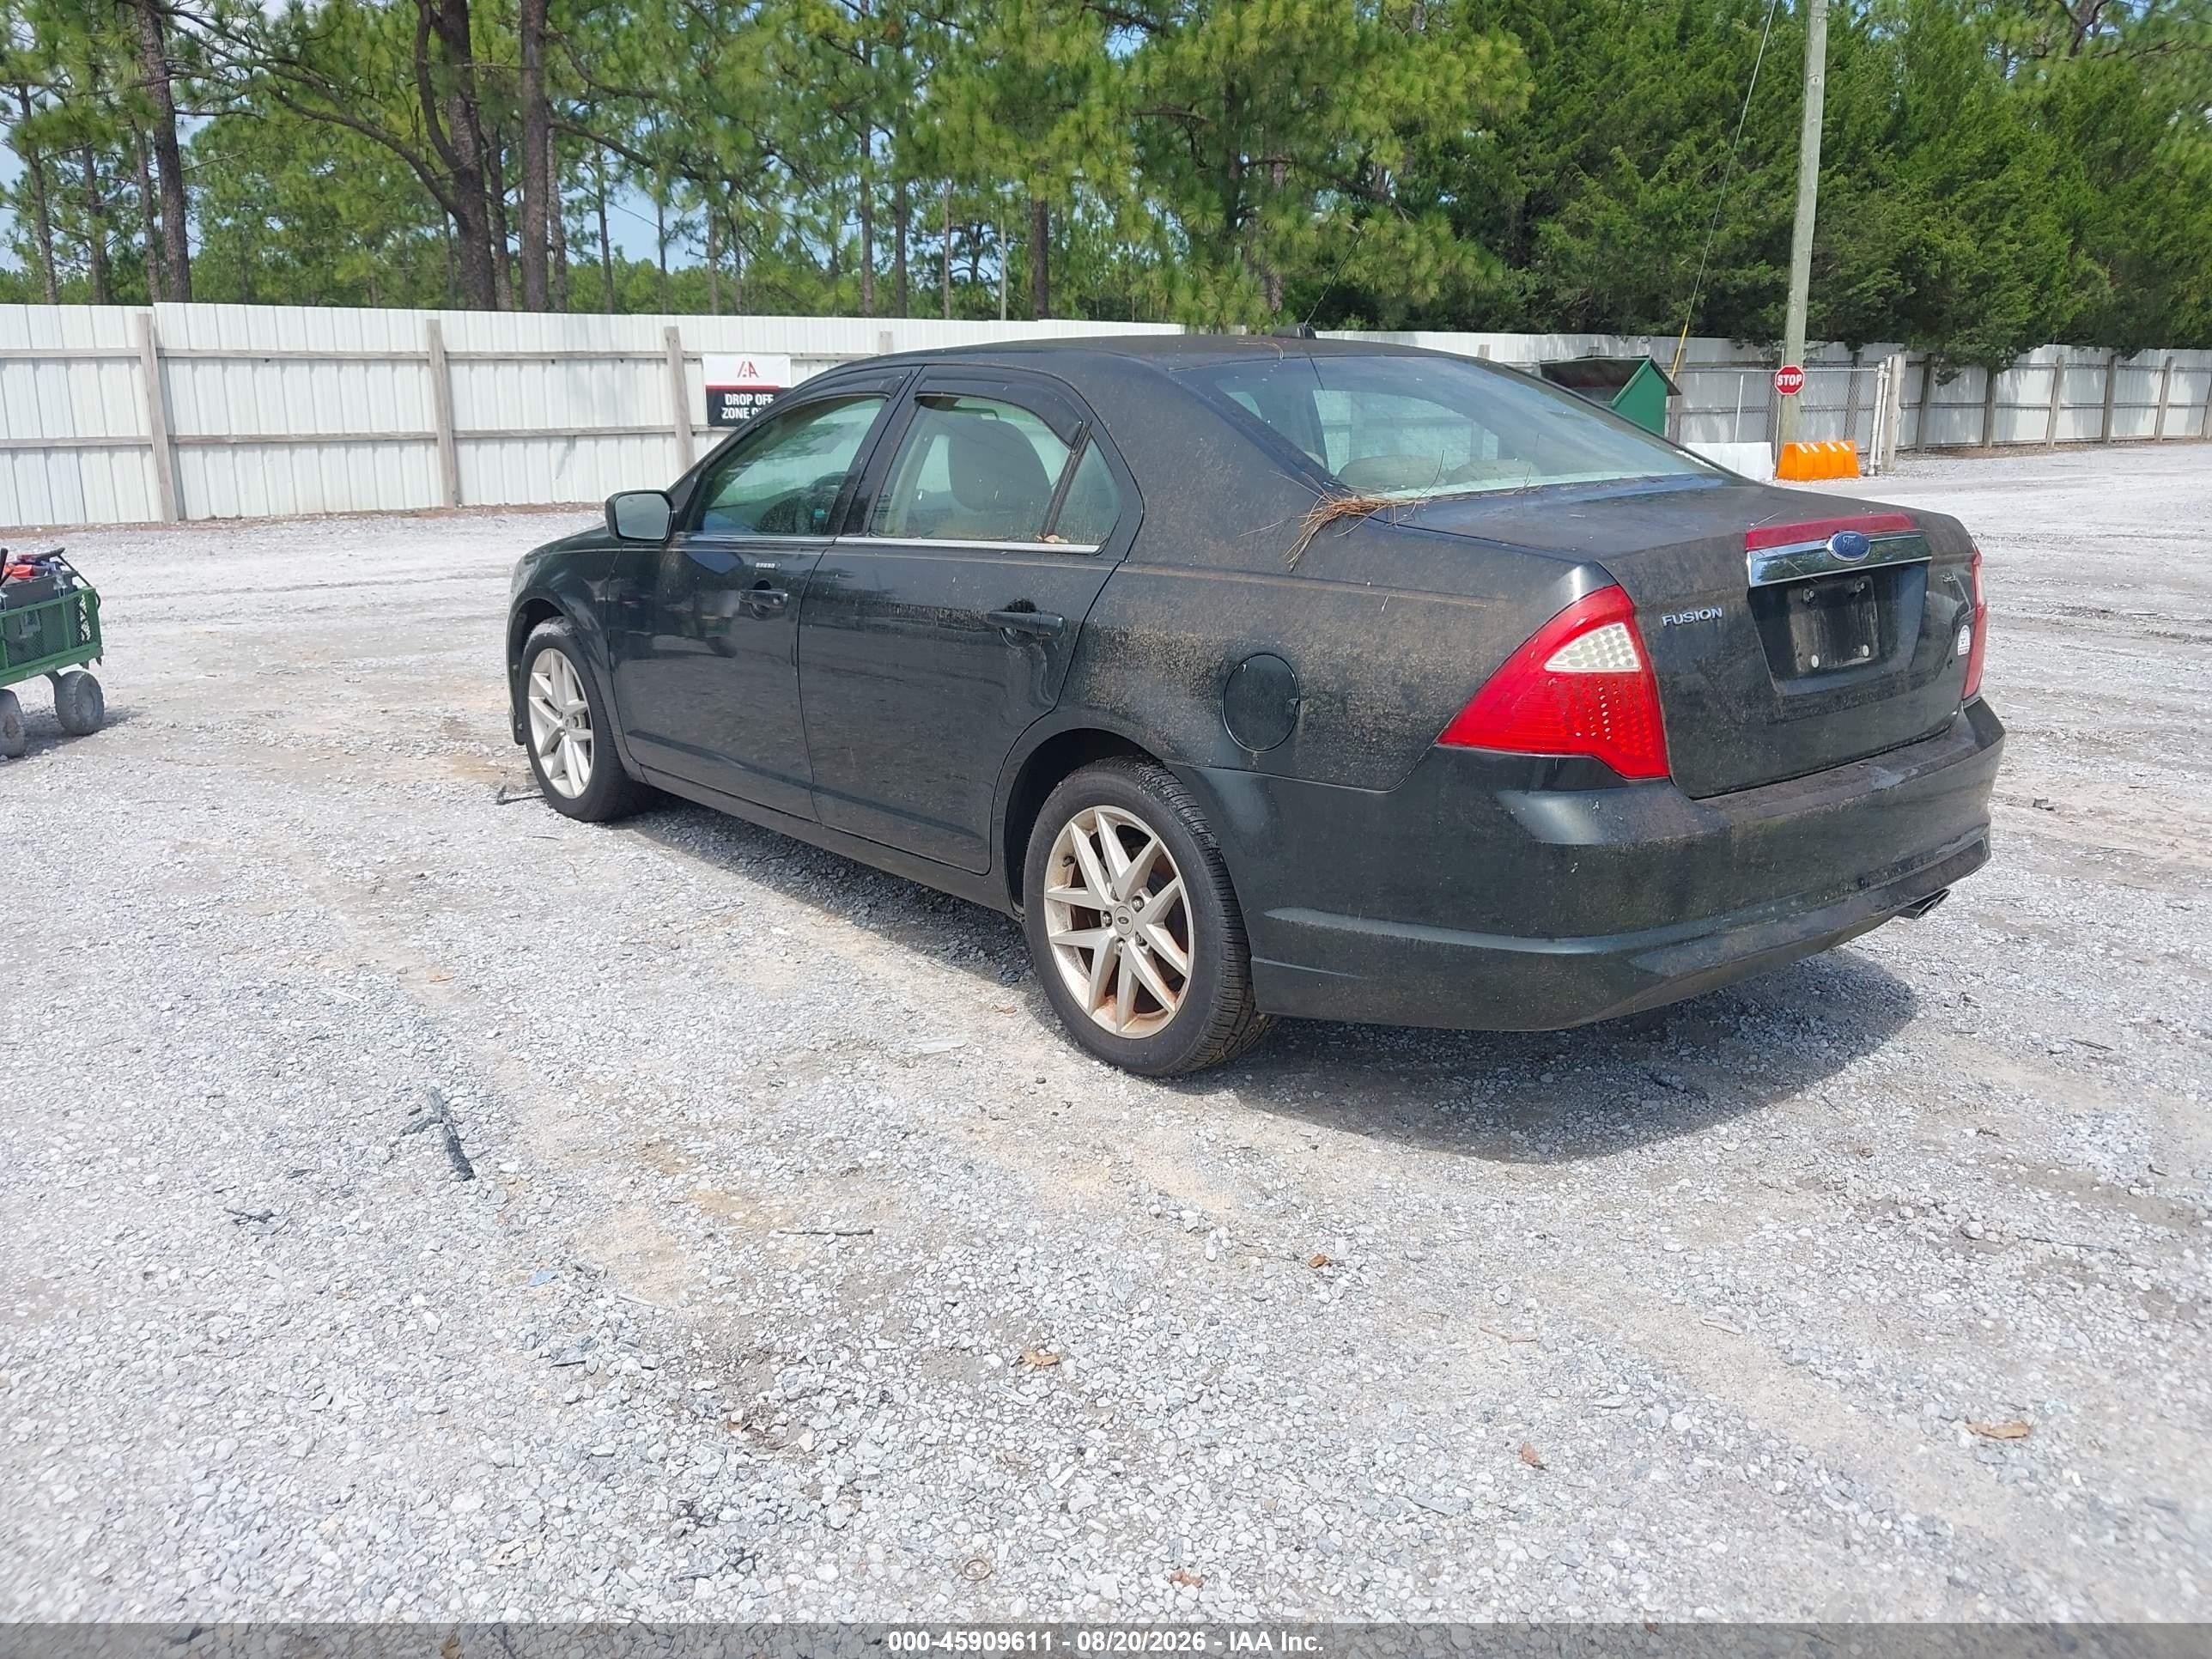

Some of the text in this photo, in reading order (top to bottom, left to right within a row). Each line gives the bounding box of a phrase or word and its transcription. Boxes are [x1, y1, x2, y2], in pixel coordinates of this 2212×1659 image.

[1777, 374, 1802, 386] STOP
[724, 392, 774, 405] DROP OFF
[721, 406, 750, 419] ZONE
[1661, 607, 1723, 627] FUSION
